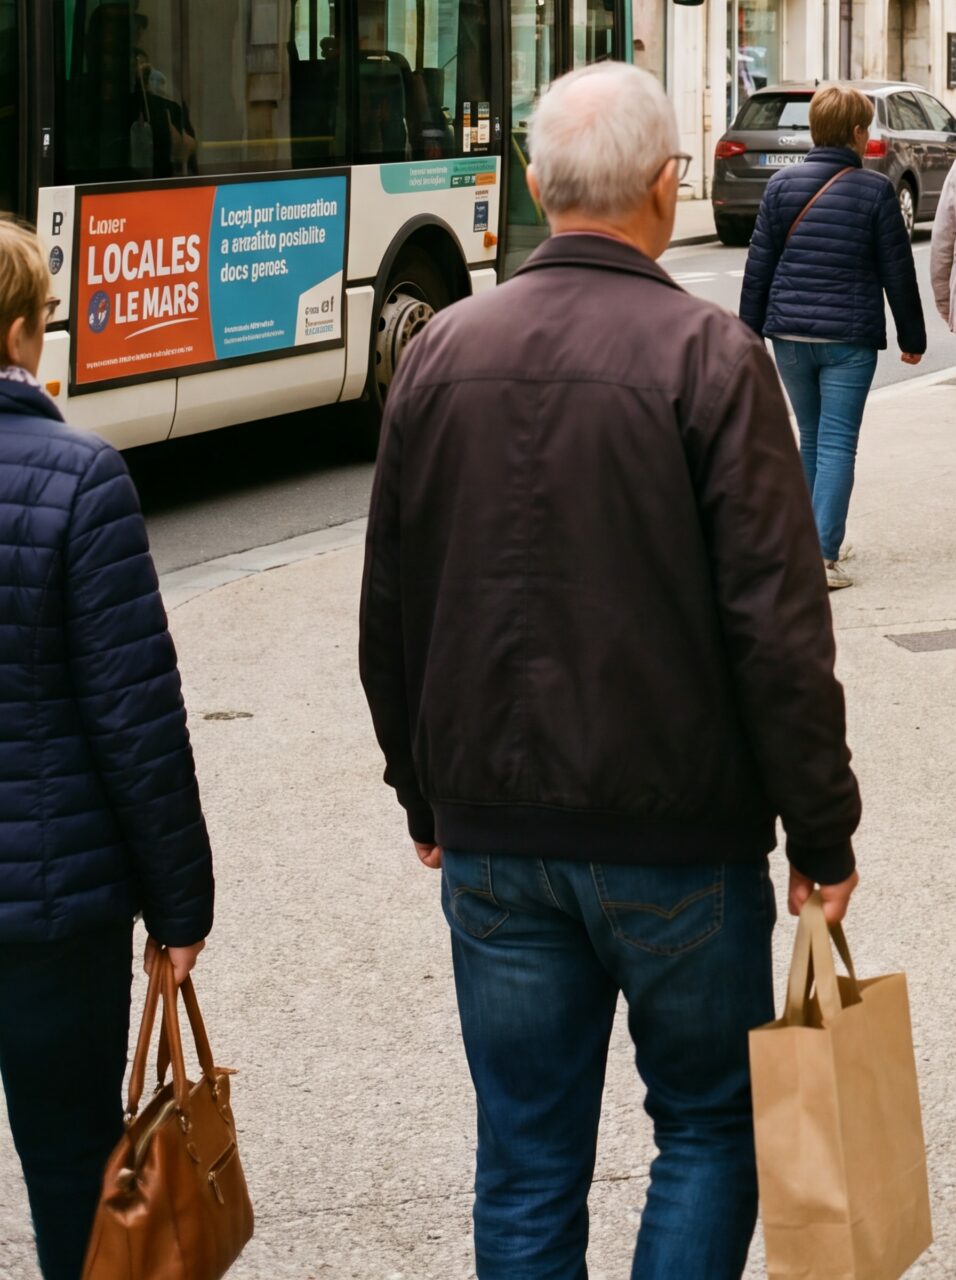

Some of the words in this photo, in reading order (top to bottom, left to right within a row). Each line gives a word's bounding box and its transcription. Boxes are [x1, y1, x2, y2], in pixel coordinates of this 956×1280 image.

[88, 234, 201, 285] LOCALES
[115, 290, 139, 324] LE
[142, 281, 199, 320] MARS
